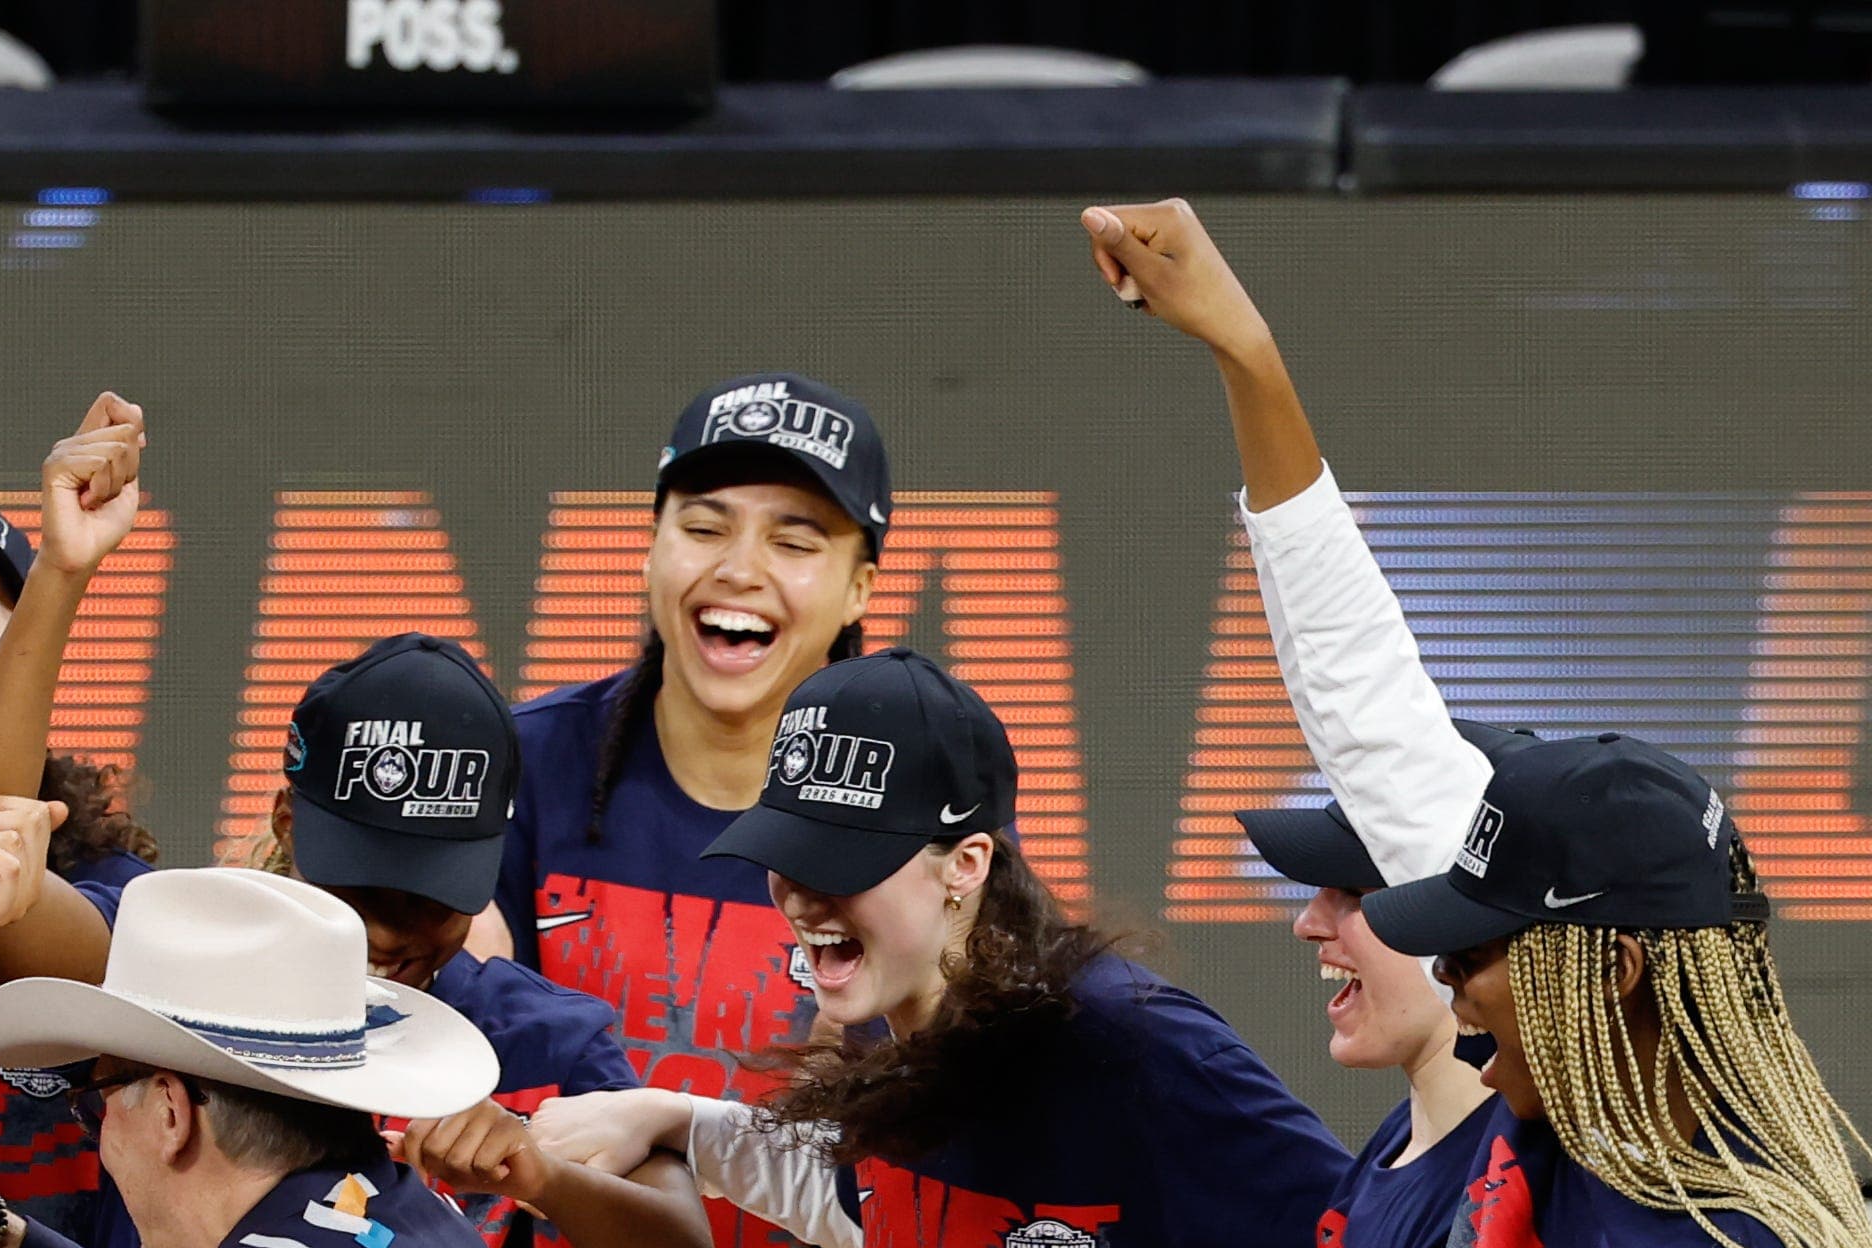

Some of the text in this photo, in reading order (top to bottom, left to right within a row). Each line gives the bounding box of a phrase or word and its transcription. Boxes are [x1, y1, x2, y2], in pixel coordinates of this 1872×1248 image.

[345, 0, 519, 74] POSS.
[709, 381, 790, 416] FINAL
[700, 399, 855, 458] FOUR
[344, 720, 425, 747] FINAL
[779, 705, 828, 737] FINAL
[335, 743, 490, 801] FOUR
[763, 729, 895, 793] FOUR
[408, 803, 476, 816] 2026 NCAA
[805, 788, 876, 808] 2026 NCAA
